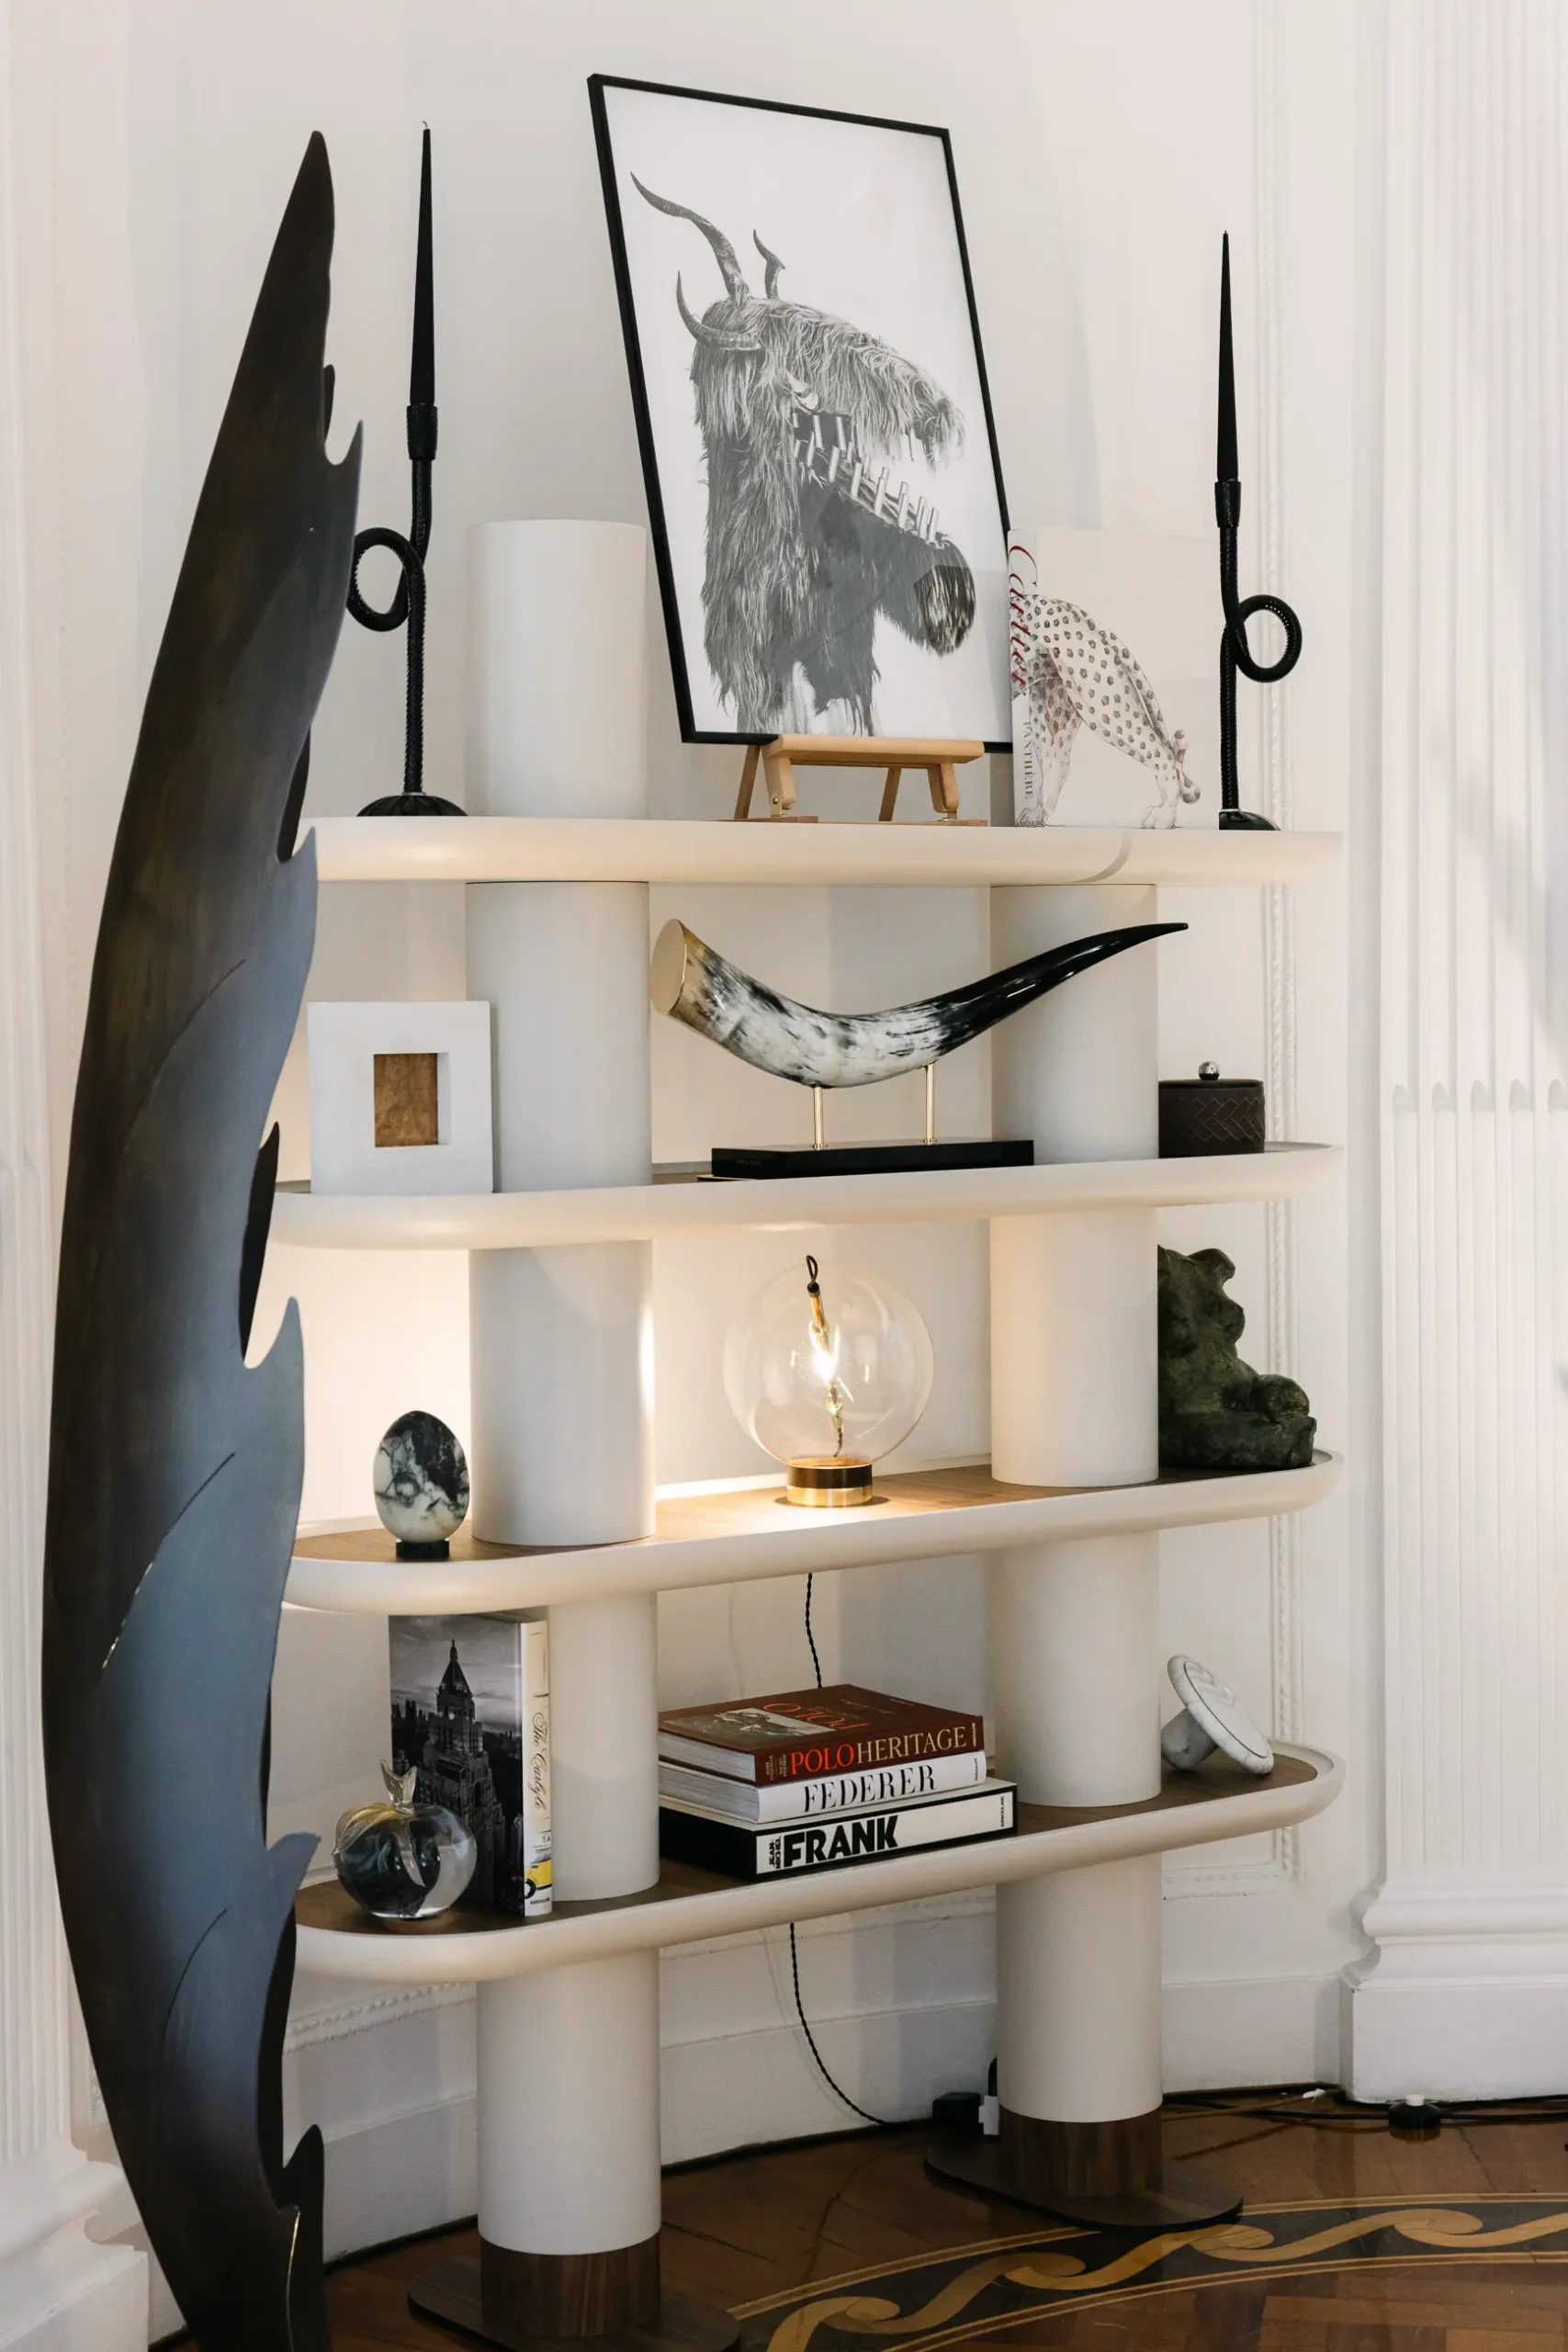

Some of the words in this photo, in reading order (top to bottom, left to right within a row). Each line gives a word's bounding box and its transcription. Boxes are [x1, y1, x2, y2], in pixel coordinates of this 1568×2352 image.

[1009, 546, 1039, 686] Cartier
[533, 1712, 548, 1746] The
[790, 1743, 855, 1776] POLO
[856, 1726, 966, 1765] HERITAGE
[526, 1747, 548, 1811] Carlyle
[803, 1764, 937, 1814] FEDERER
[784, 1815, 899, 1869] FRANK
